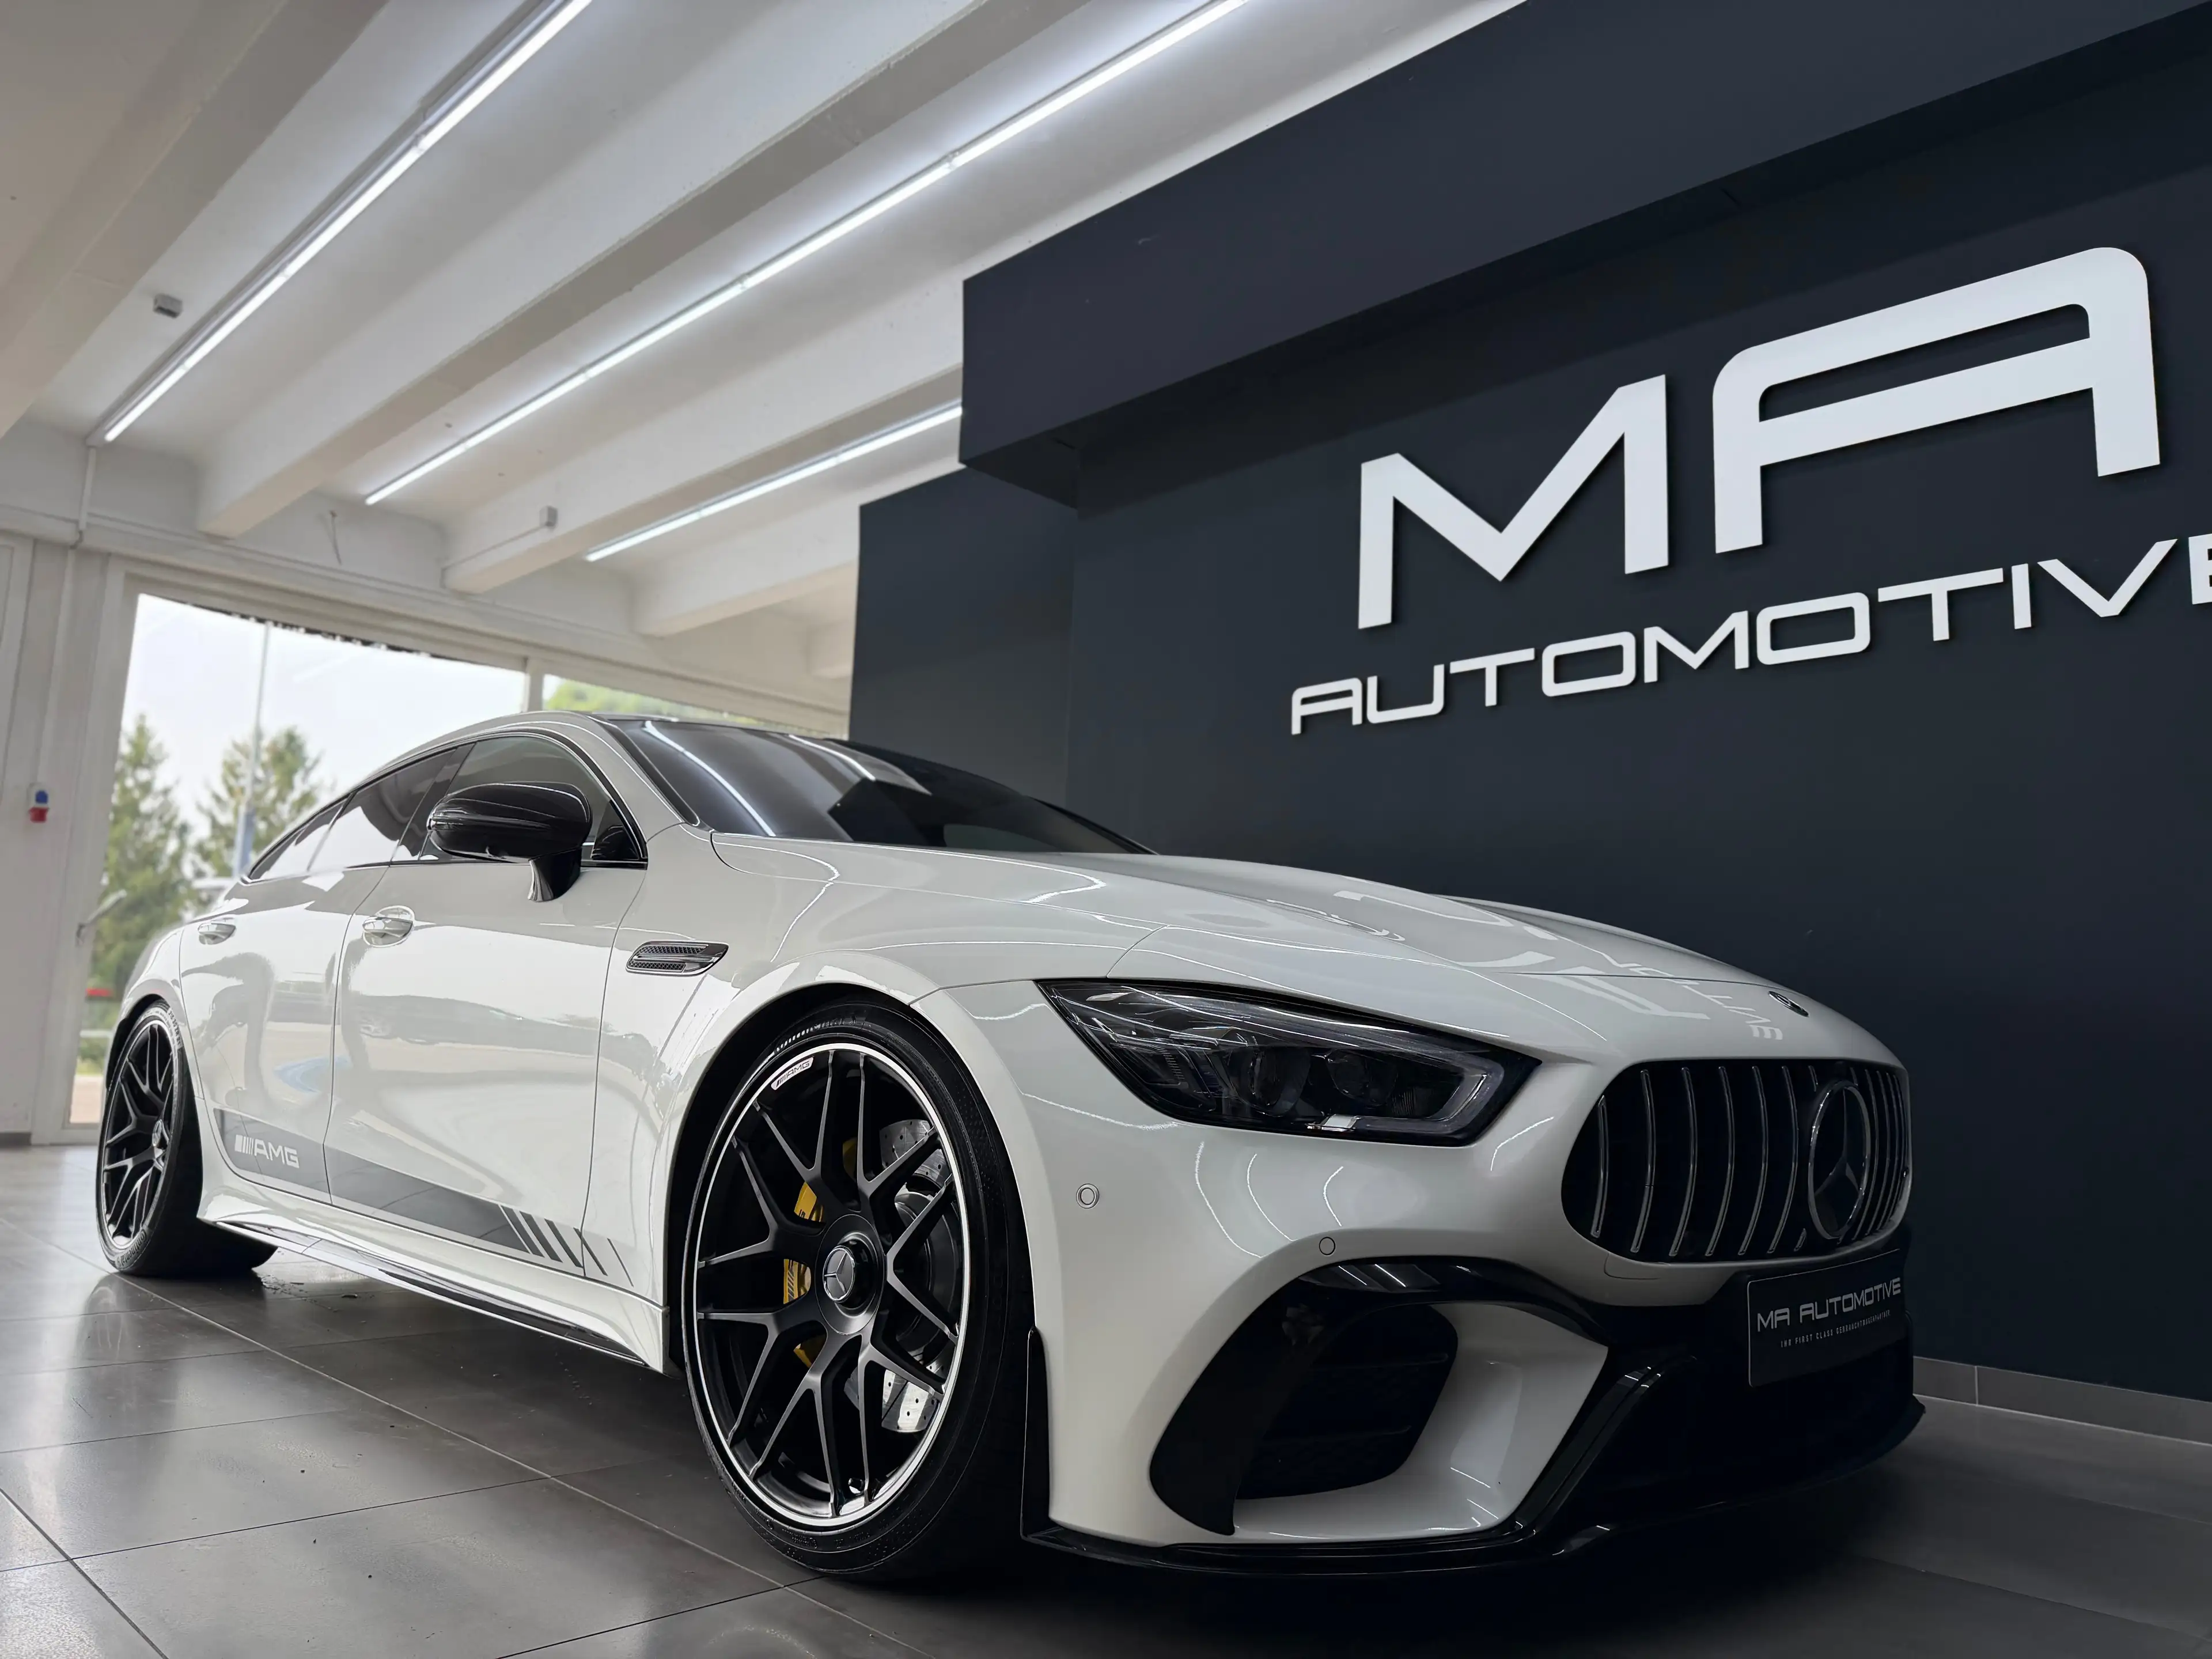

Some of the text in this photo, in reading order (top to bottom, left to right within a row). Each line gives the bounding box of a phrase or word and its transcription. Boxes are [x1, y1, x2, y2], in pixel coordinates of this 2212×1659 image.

[1358, 247, 2160, 630] MA
[1291, 533, 2212, 735] AUTOMOTIV
[786, 1061, 810, 1078] AMG
[254, 1138, 300, 1168] AMG
[1757, 1277, 1901, 1332] MA AUTOMOTIVE
[1795, 1334, 1813, 1344] FIRST
[1816, 1329, 1833, 1339] CLASS
